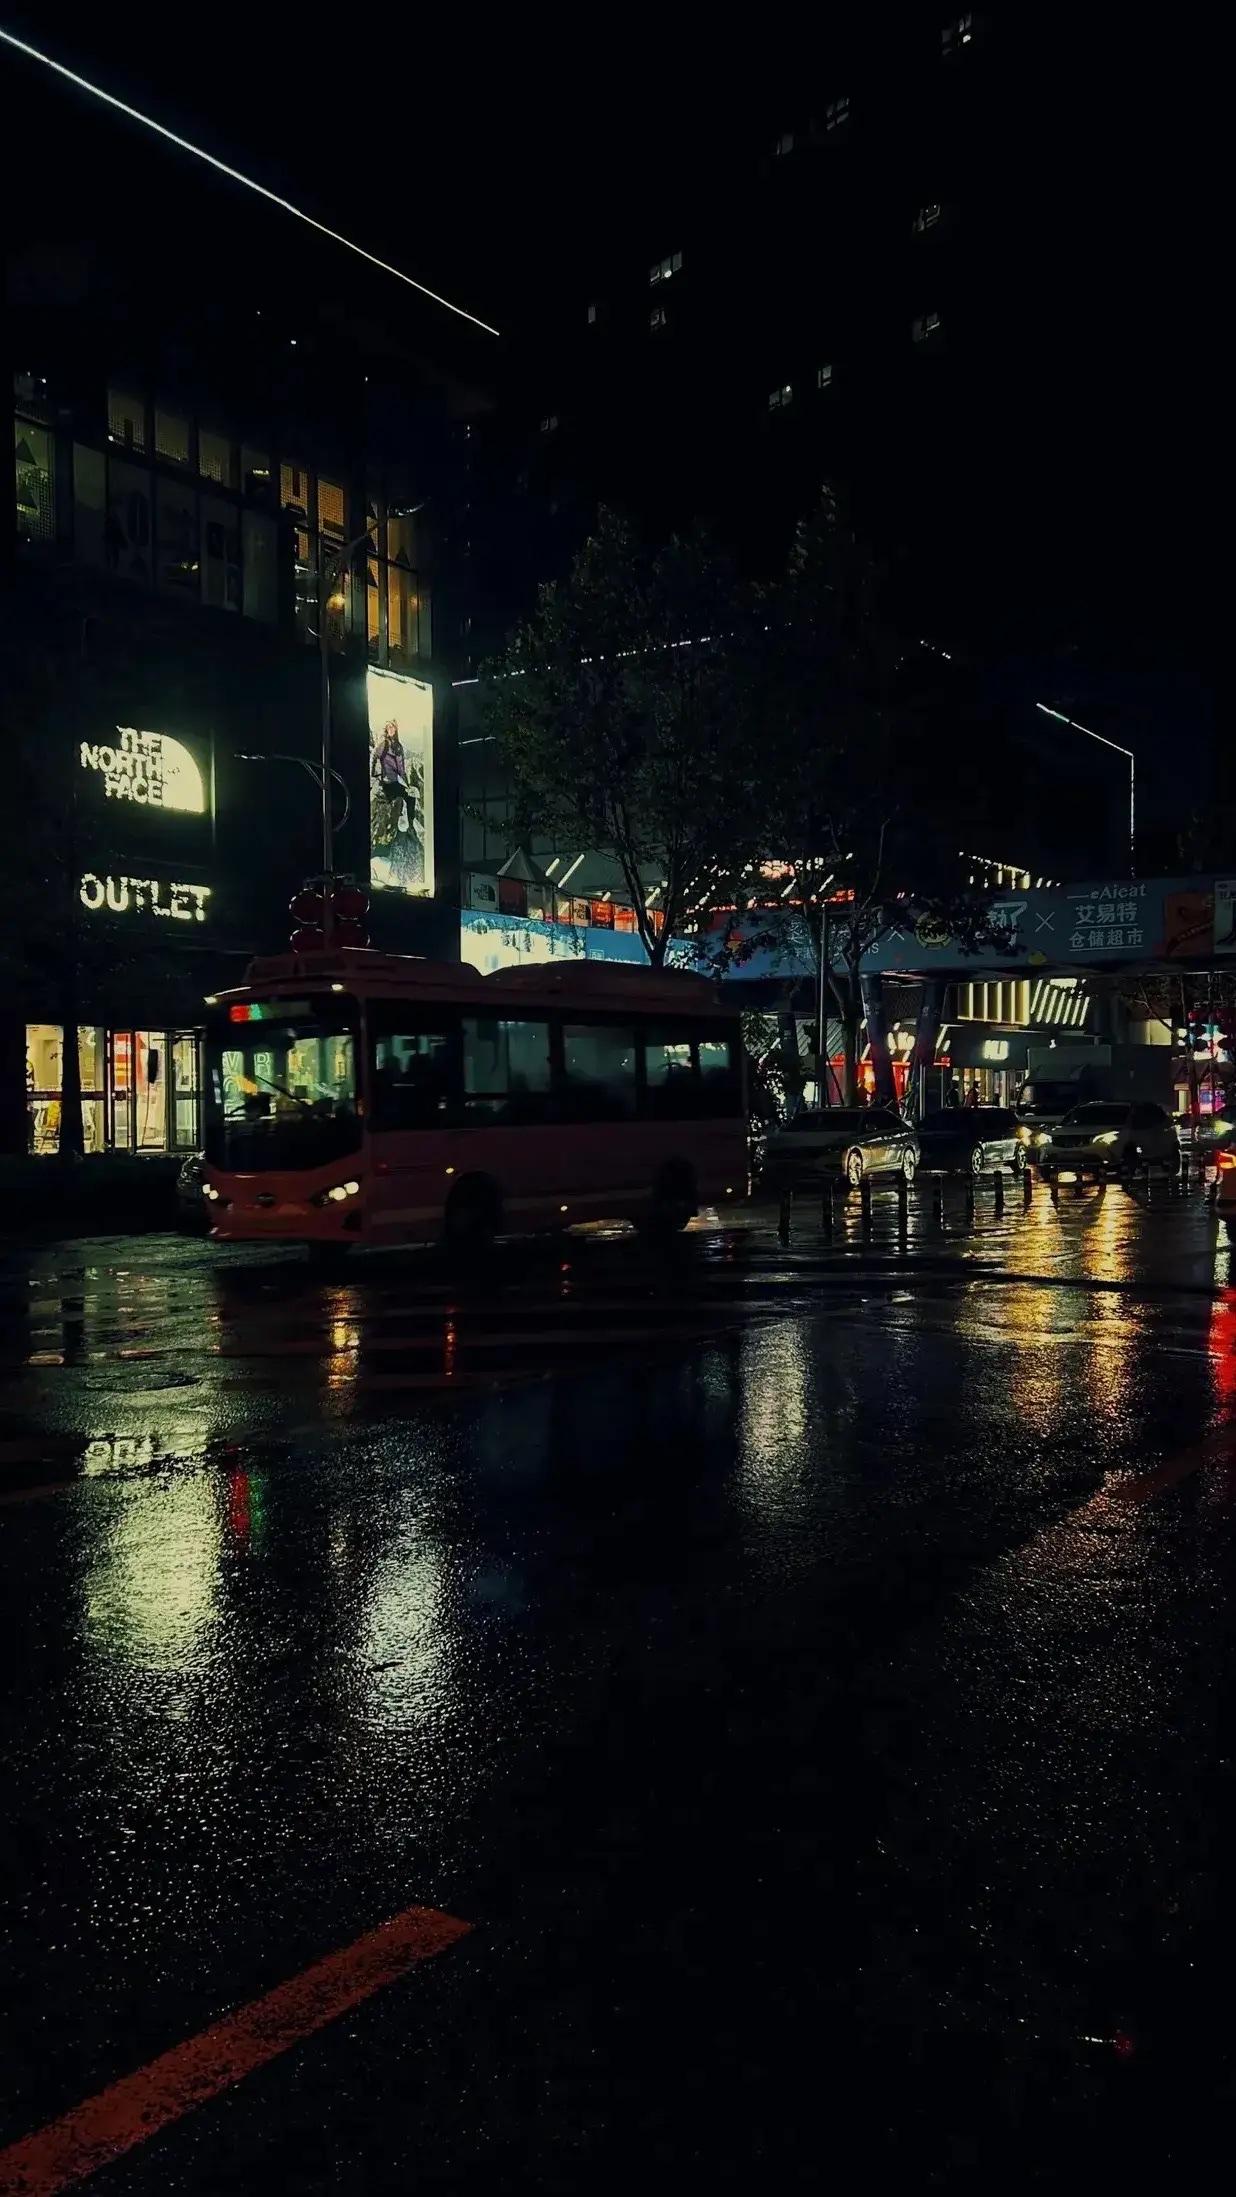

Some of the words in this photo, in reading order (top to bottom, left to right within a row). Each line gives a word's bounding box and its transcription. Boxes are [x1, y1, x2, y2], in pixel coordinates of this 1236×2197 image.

[116, 725, 162, 754] THE
[80, 741, 163, 781] NORTH
[105, 772, 163, 807] FACE
[80, 872, 212, 923] OUTLET
[1074, 901, 1138, 925] 艾易特
[1068, 927, 1144, 948] 仓储超市
